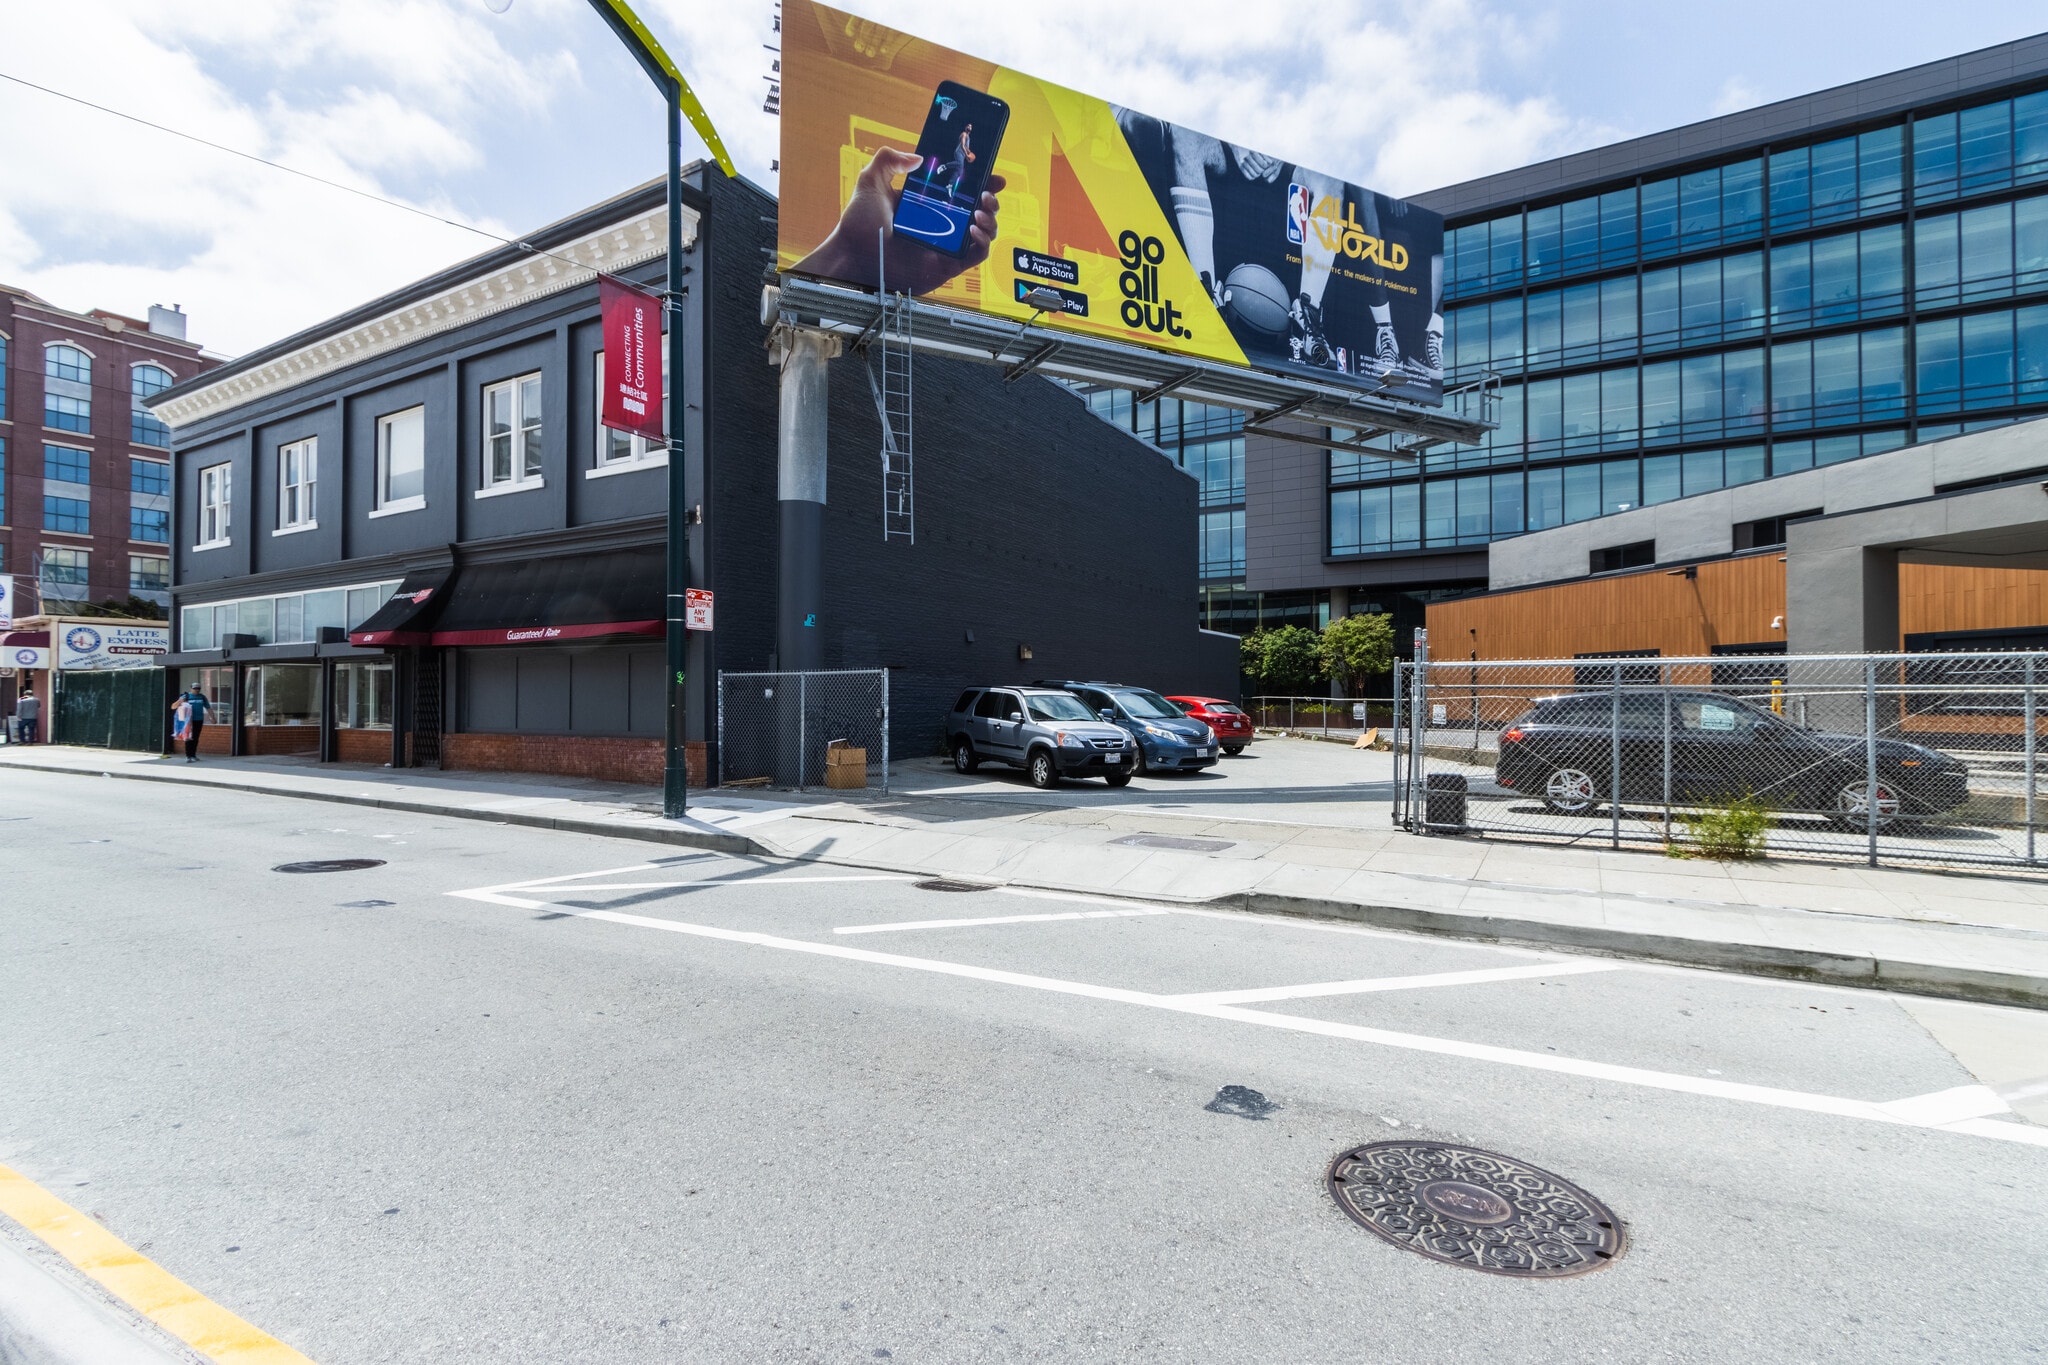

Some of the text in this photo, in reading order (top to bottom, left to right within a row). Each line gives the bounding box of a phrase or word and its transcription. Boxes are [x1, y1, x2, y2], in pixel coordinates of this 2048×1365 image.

[1309, 195, 1364, 233] ALL
[1118, 229, 1164, 271] go
[1311, 219, 1409, 272] WORLD
[1032, 255, 1056, 266] Download
[1032, 262, 1074, 280] App Store
[1286, 253, 1302, 264] From
[1344, 269, 1354, 279] the
[1355, 273, 1375, 285] makers
[1376, 278, 1382, 286] of
[1385, 280, 1409, 293] Pokémon
[1409, 286, 1418, 295] GO
[1119, 263, 1158, 305] all
[1067, 299, 1084, 313] Play
[1120, 299, 1193, 340] out.
[624, 325, 632, 382] CONNECTING
[633, 307, 644, 389] Communities
[1288, 357, 1307, 365] NIANTIC
[694, 608, 705, 616] ANY
[107, 637, 168, 646] EXPRESS
[117, 629, 160, 638] LATTE
[506, 627, 561, 641] Guaranteed Rate
